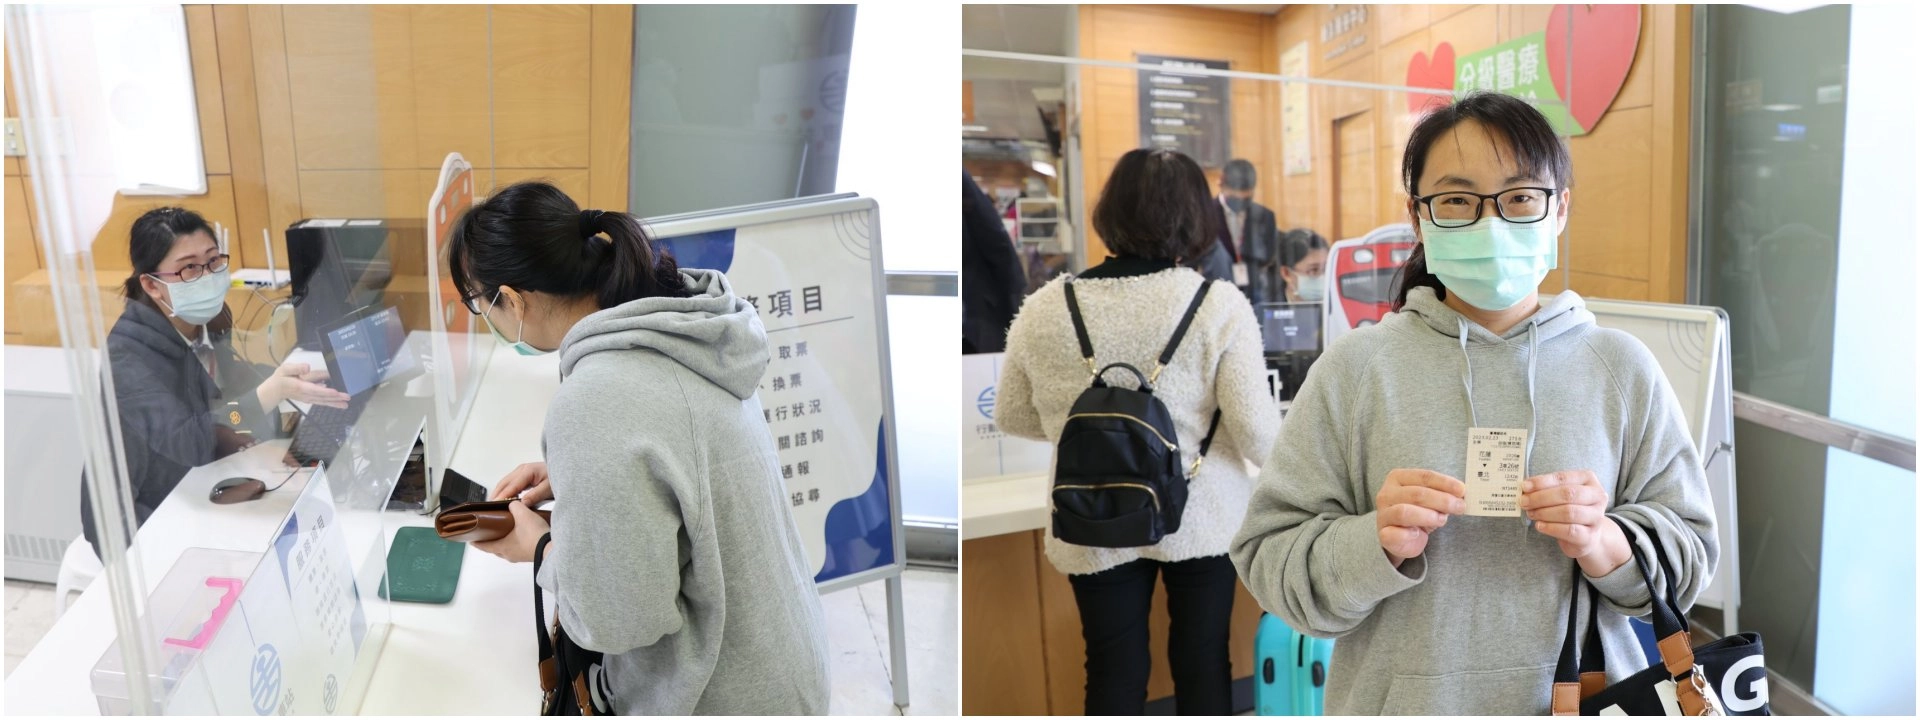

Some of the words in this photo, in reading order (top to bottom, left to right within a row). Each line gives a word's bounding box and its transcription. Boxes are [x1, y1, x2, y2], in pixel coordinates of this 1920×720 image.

[1459, 43, 1539, 95] 分級醫療
[778, 341, 808, 360] 取票
[777, 429, 824, 452] 關諮詢
[781, 461, 810, 480] 通報
[791, 488, 820, 507] 協尋
